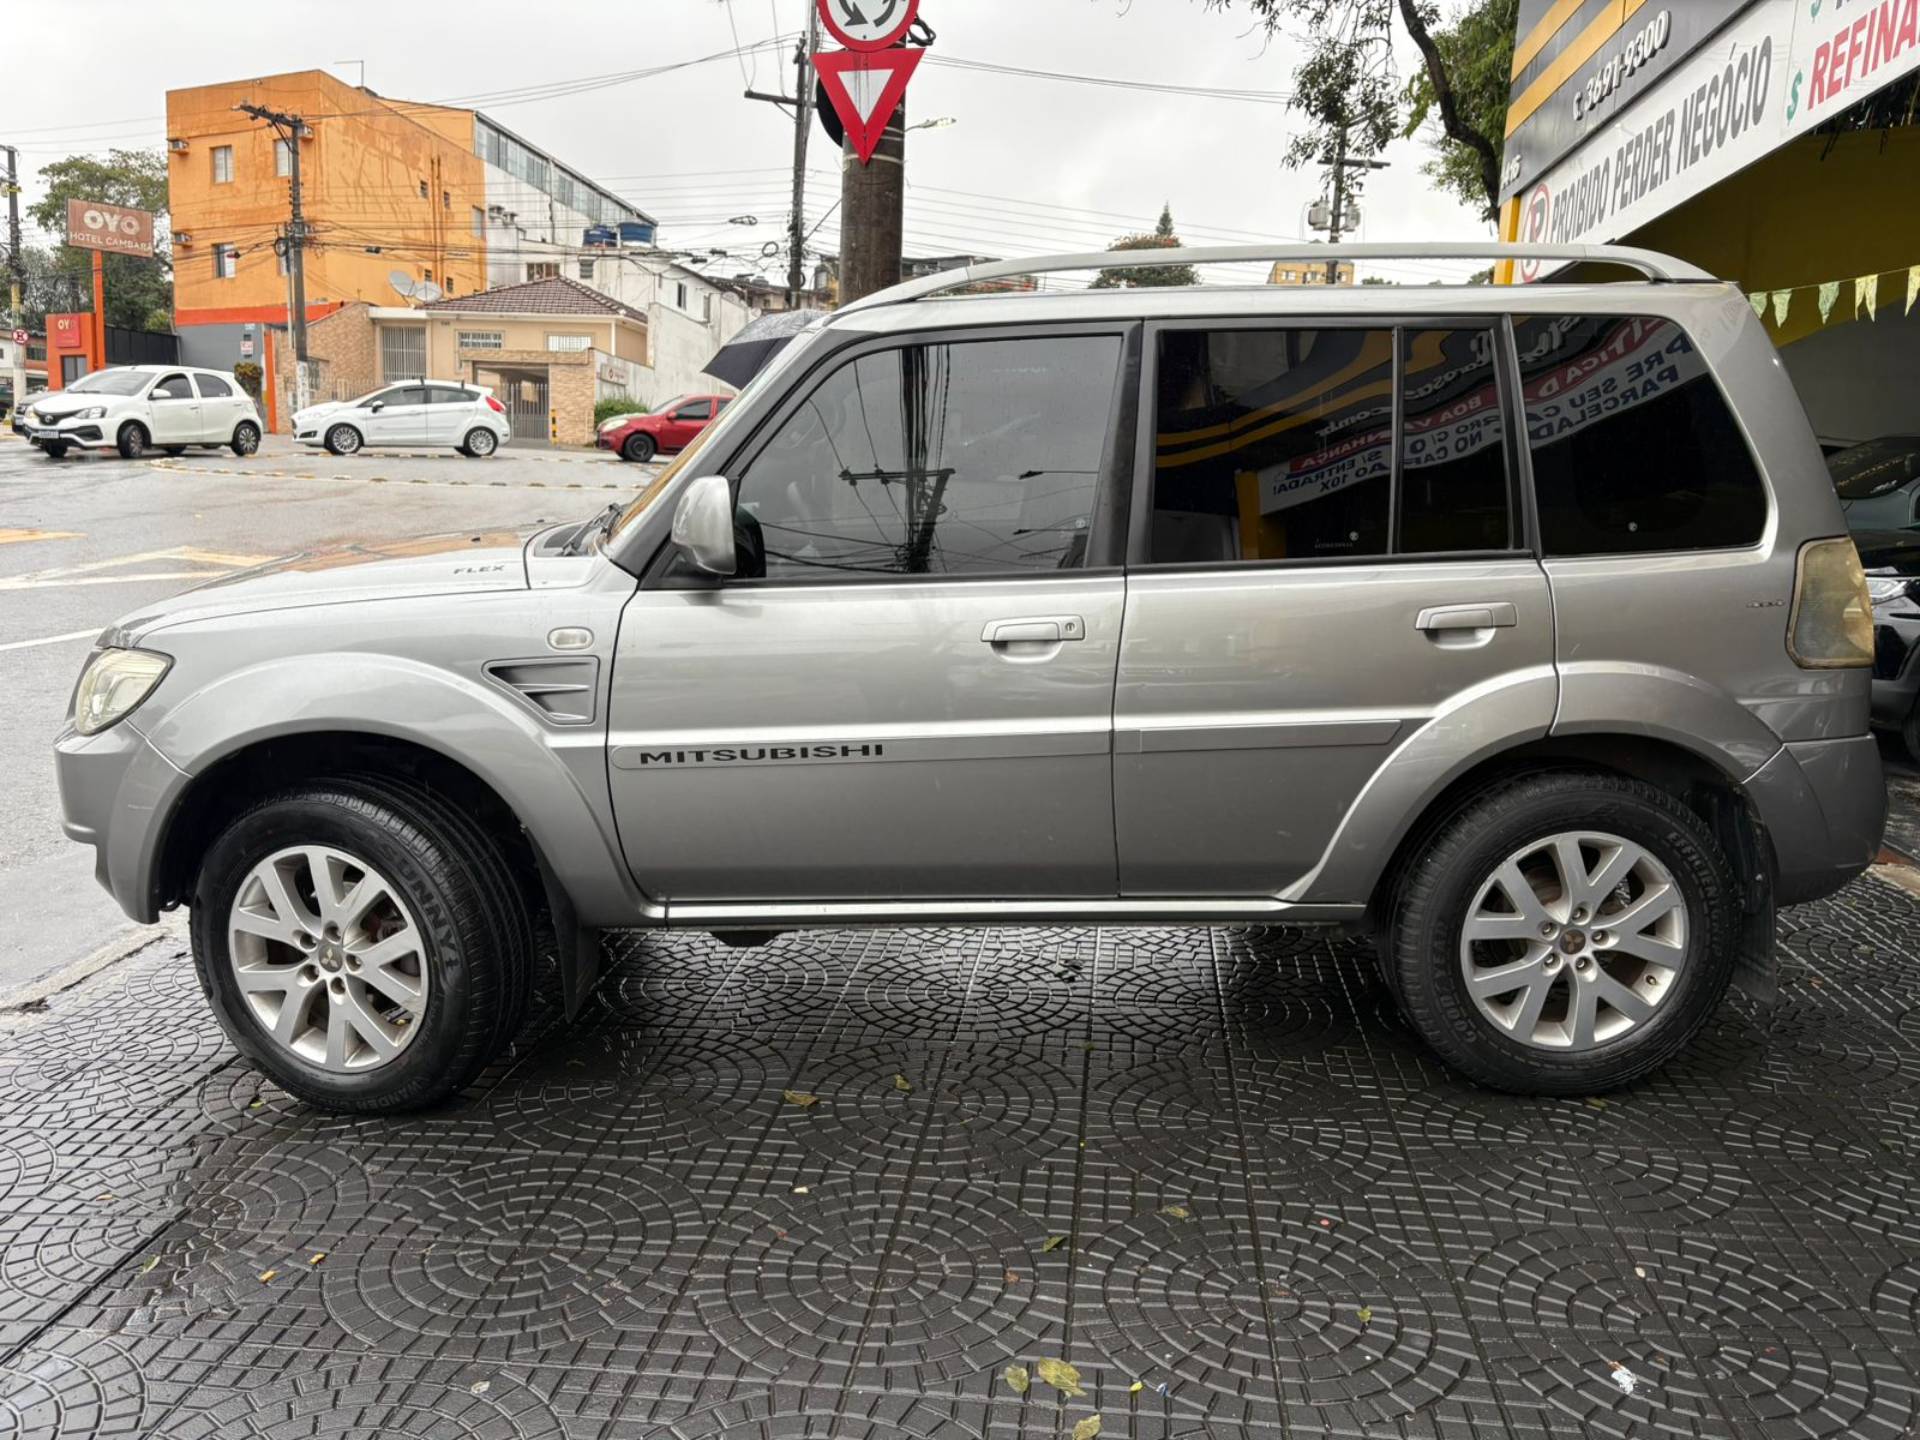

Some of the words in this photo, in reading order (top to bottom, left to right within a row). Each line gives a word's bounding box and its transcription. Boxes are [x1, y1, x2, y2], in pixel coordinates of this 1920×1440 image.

[1584, 10, 1669, 111] 3691-9300
[1808, 0, 1920, 111] REFINA
[1550, 157, 1610, 243] PROIBIDO
[1611, 108, 1675, 216] PERDER
[1676, 35, 1772, 174] NEGÓCIO
[83, 209, 141, 236] OYO
[70, 231, 104, 244] HOTEL
[453, 564, 505, 575] FLEX
[640, 743, 884, 765] MITSUBISHI
